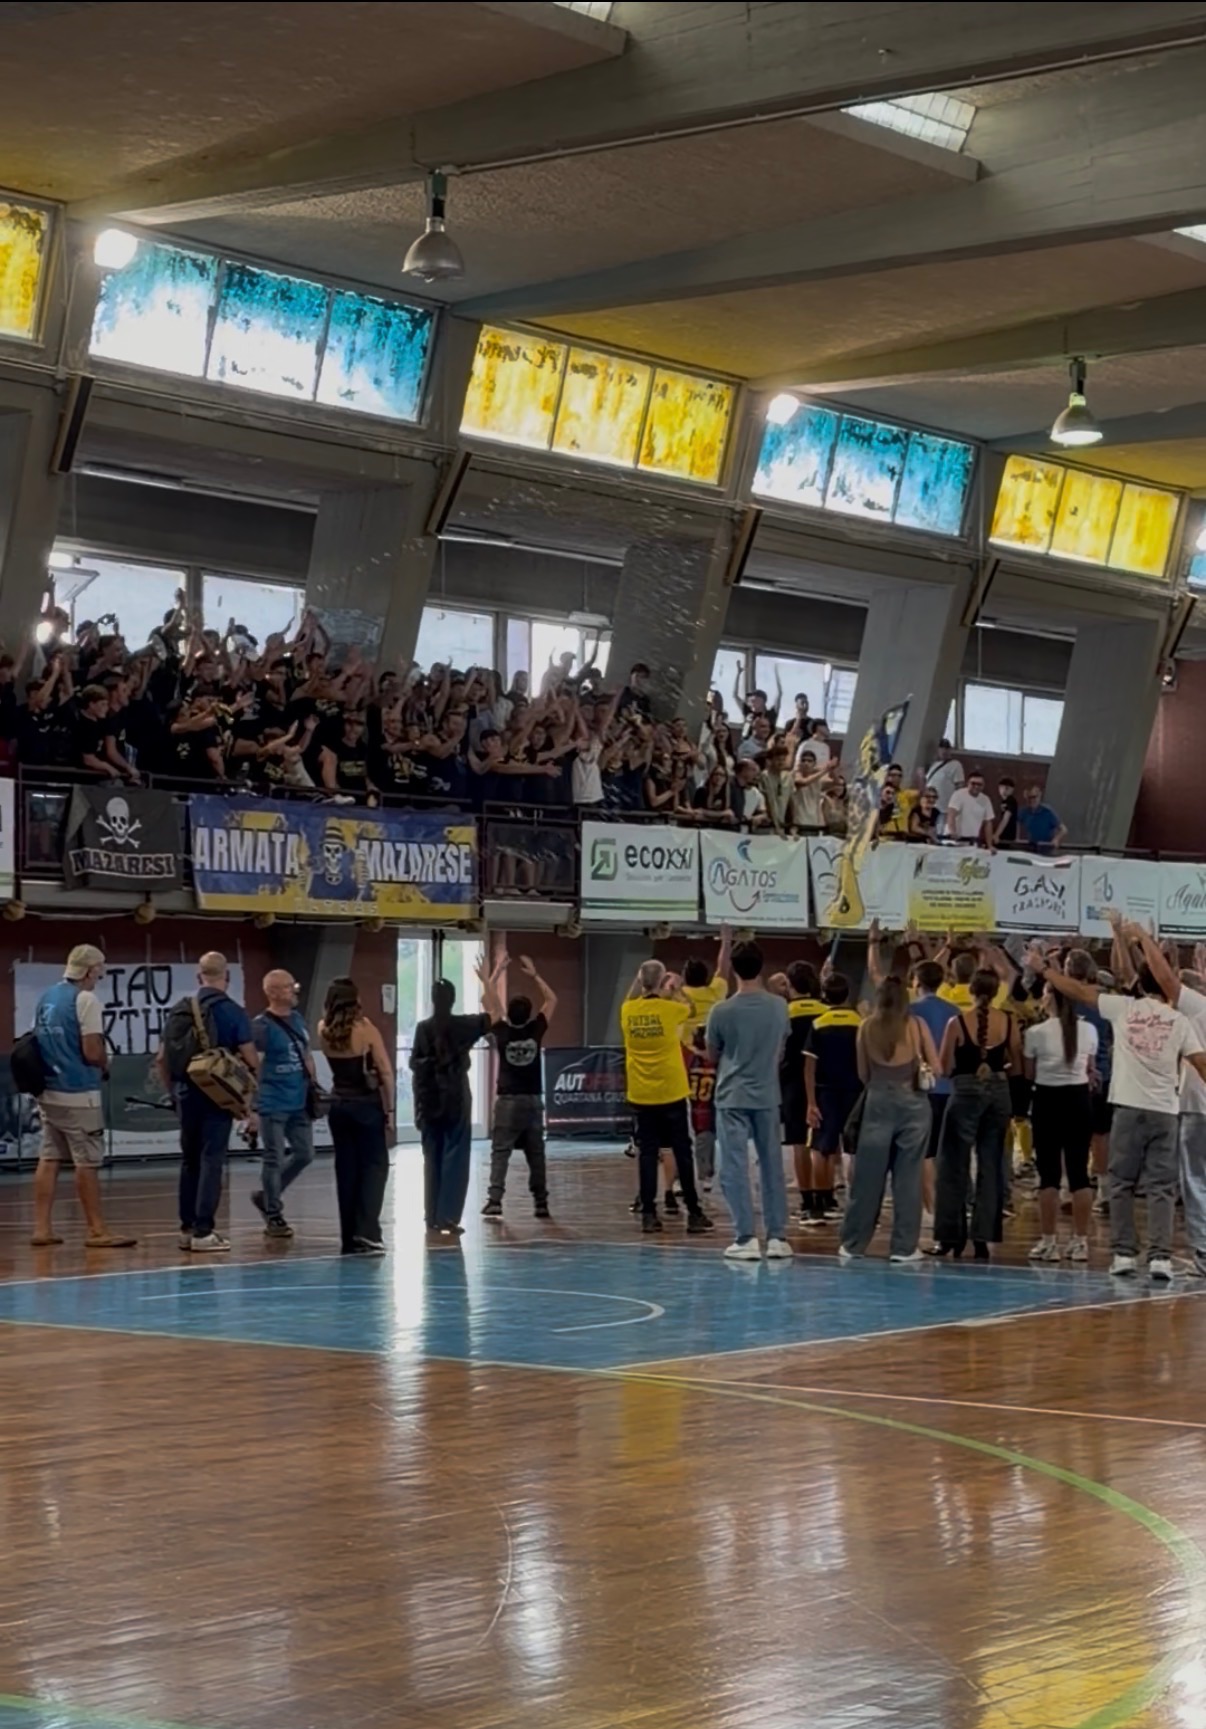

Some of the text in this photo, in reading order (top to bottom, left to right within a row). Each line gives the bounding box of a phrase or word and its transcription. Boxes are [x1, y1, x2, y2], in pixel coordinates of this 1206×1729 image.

[193, 826, 473, 884] ARMATA MAZARESE
[624, 844, 693, 870] ecoxxi
[98, 965, 172, 1009] IAO
